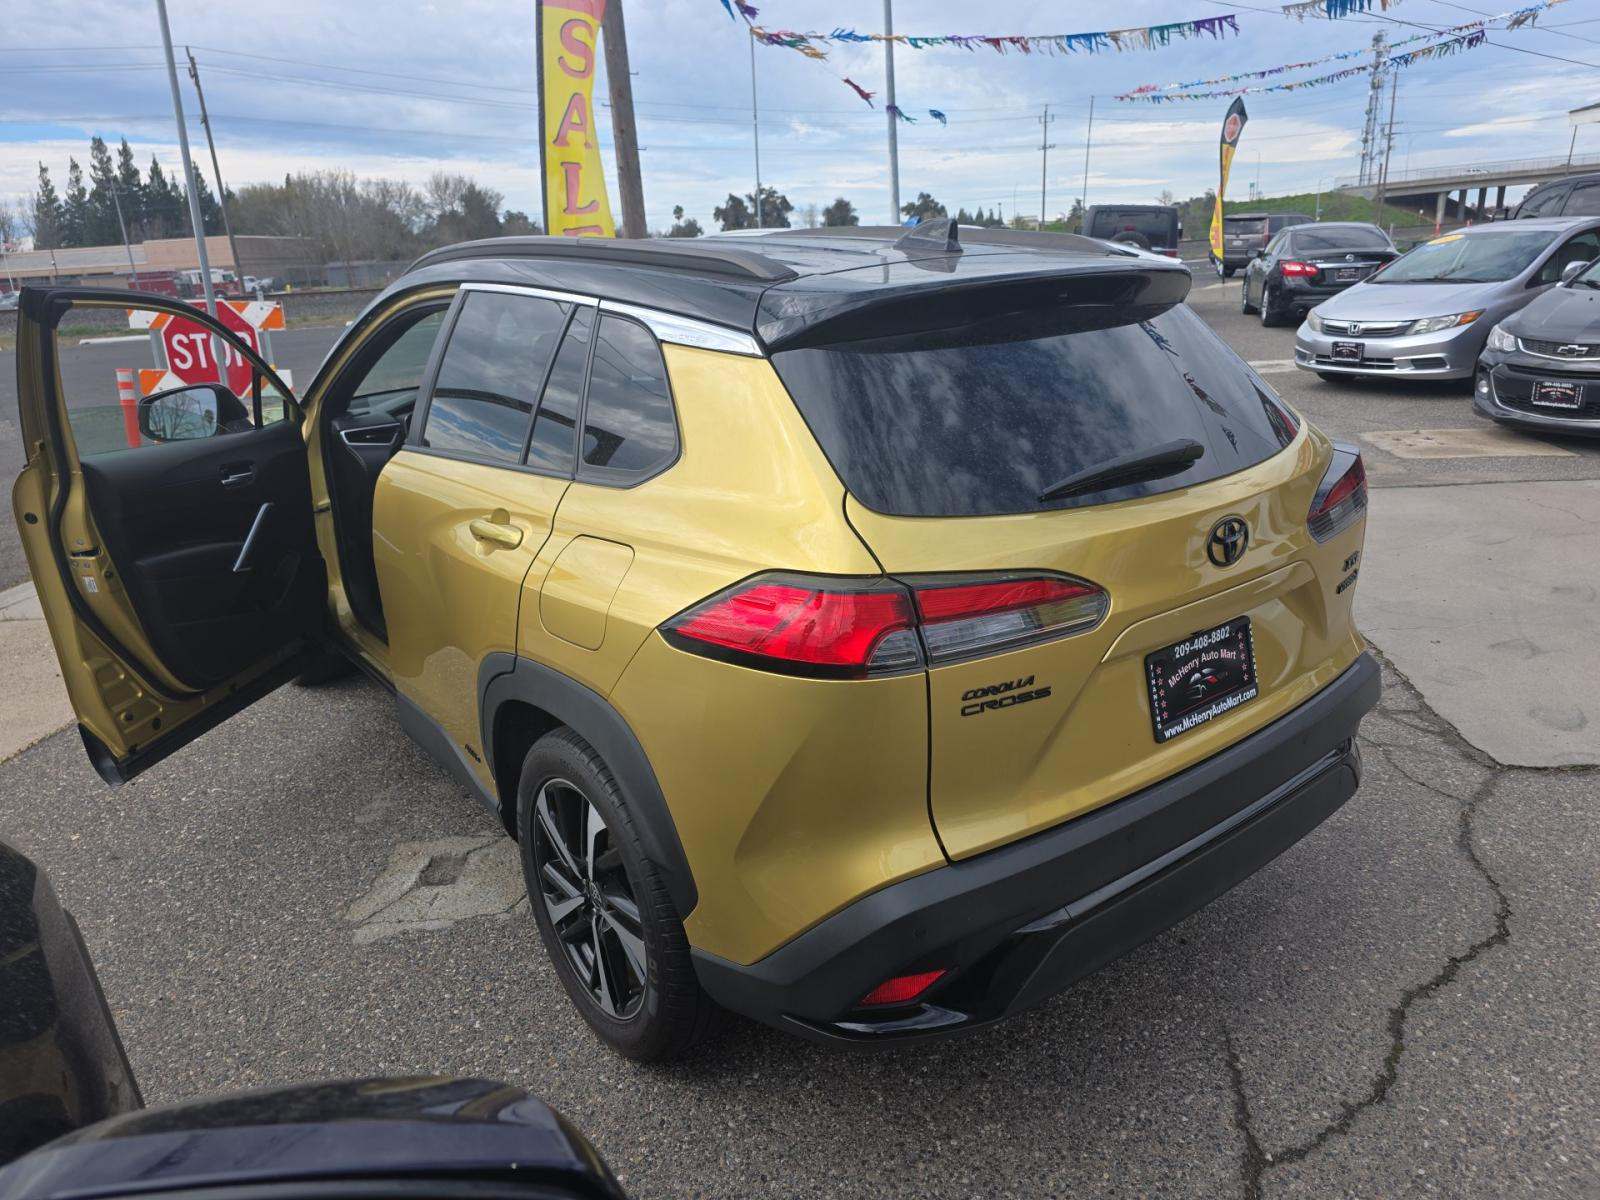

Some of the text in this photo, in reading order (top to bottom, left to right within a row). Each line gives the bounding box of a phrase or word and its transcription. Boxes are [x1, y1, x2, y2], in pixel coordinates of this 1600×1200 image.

[553, 19, 604, 237] SAL
[1174, 626, 1230, 659] 209-408-8802
[1168, 649, 1237, 687] McHenry Auto Mart
[961, 686, 1052, 716] CROSS
[962, 675, 1034, 701] COROLLA
[1164, 688, 1256, 739] www.McHenryAutoMart.com
